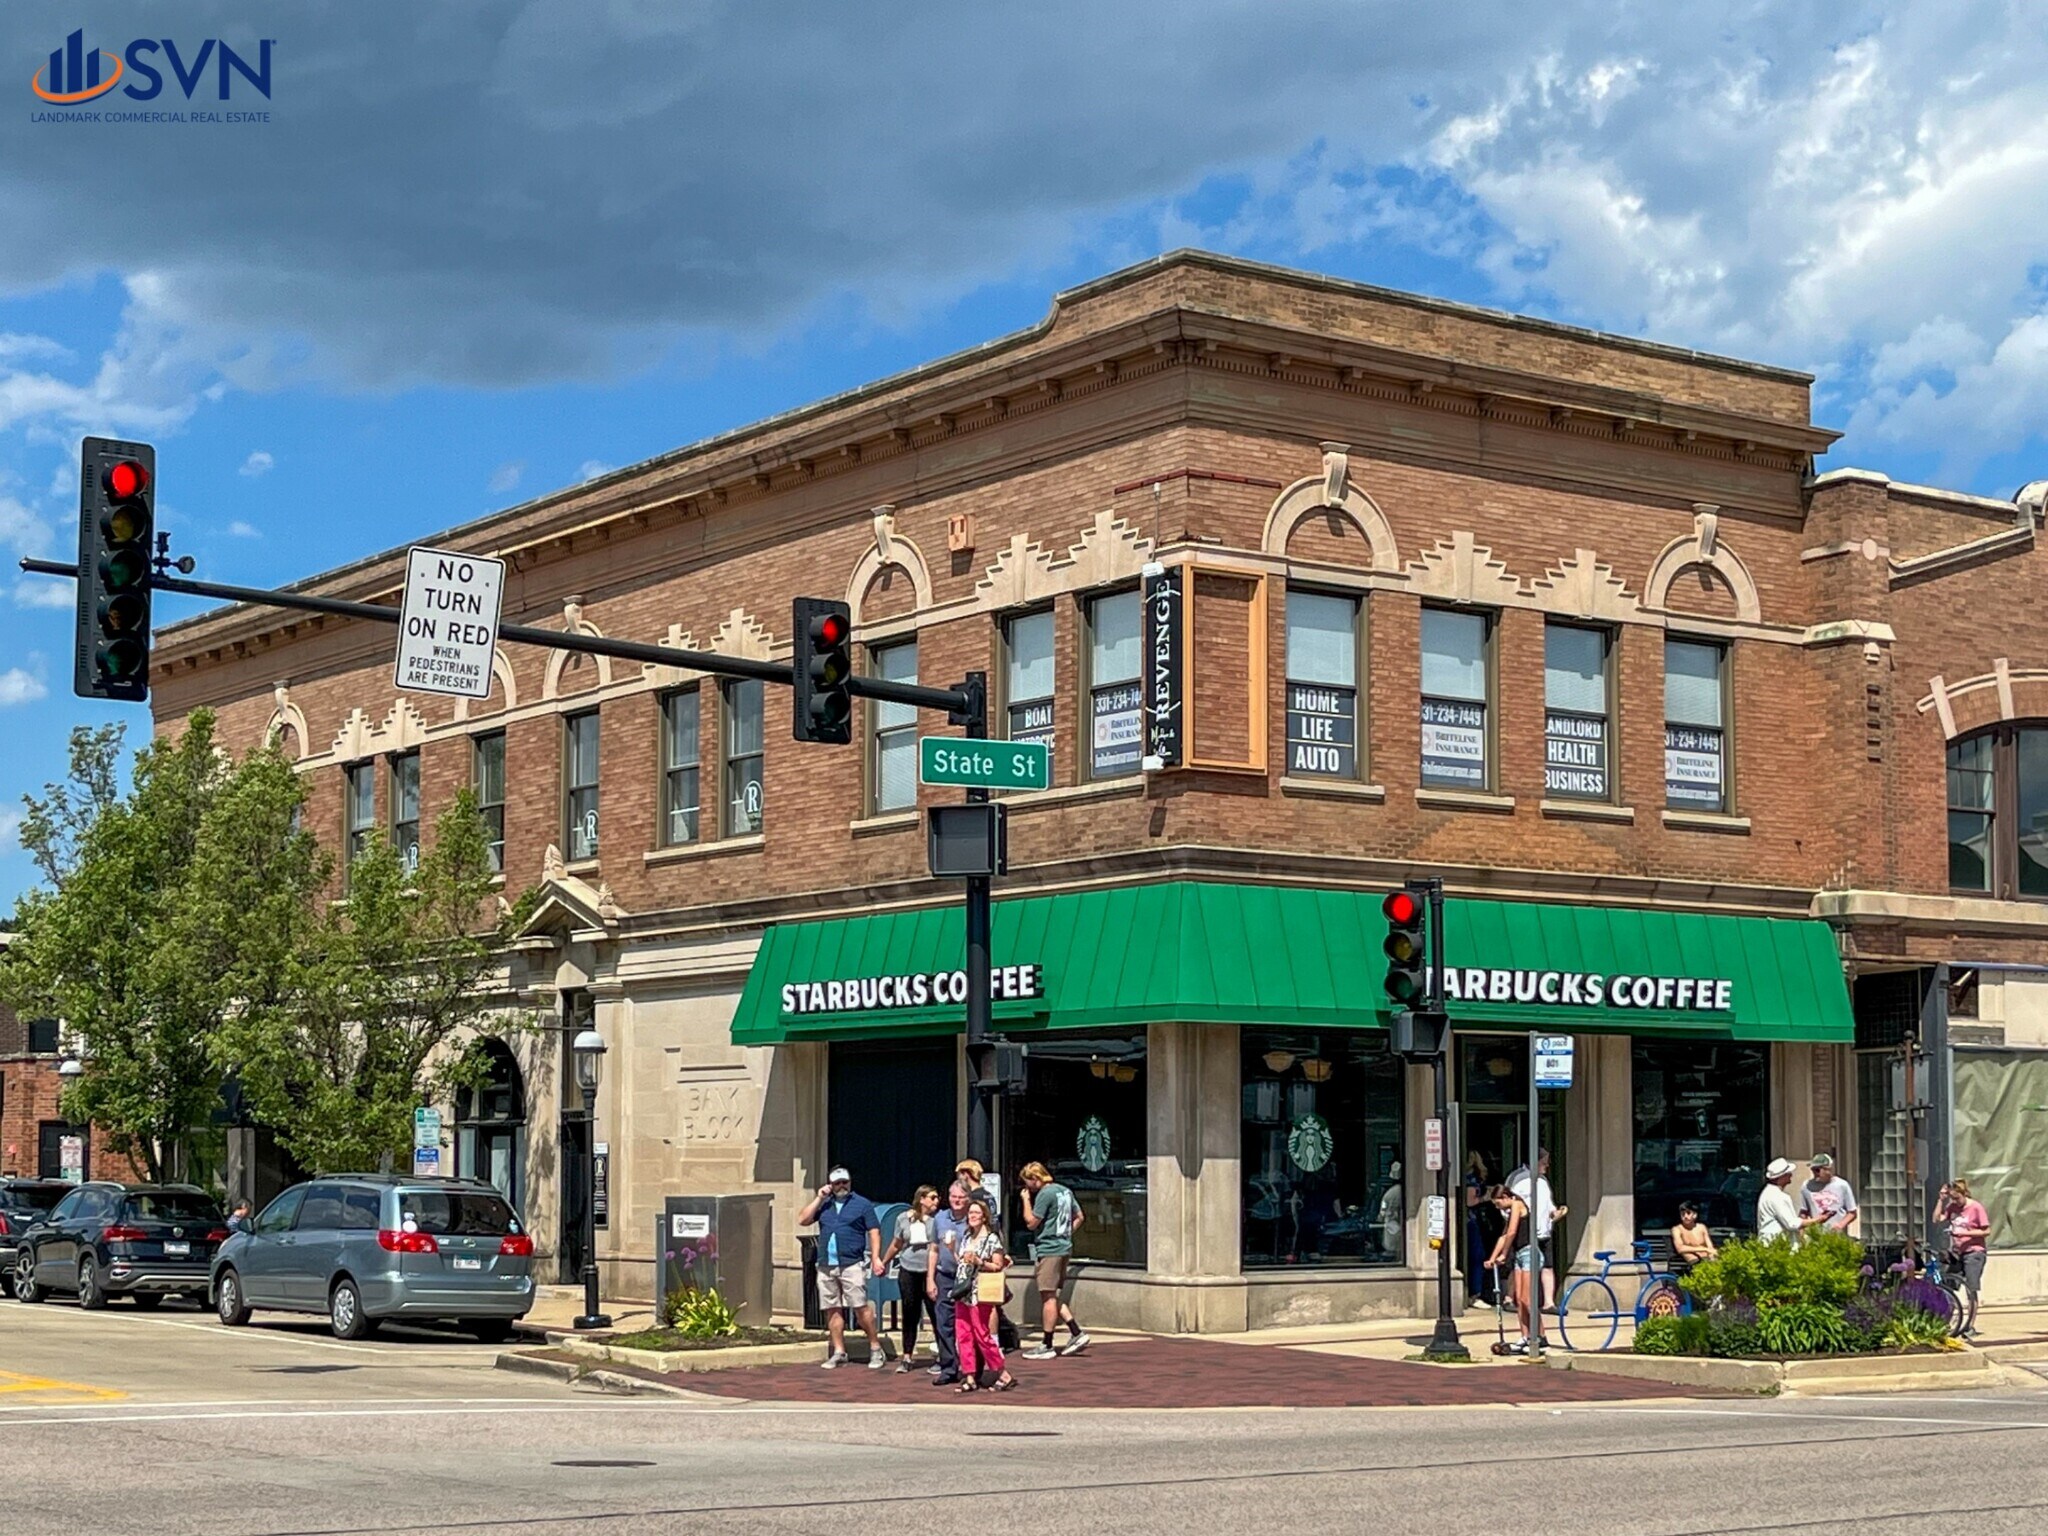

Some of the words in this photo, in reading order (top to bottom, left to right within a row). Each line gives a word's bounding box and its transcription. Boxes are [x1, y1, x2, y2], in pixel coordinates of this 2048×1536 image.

[437, 559, 474, 583] NO
[425, 588, 482, 615] TURN
[408, 617, 436, 640] ON
[448, 622, 489, 646] RED
[432, 645, 461, 660] WHEN
[1156, 579, 1171, 722] REVENGE
[409, 656, 480, 676] PEDESTRIANS
[407, 671, 428, 684] ARE
[432, 673, 479, 690] PRESENT
[1295, 687, 1340, 714] HOME
[1025, 704, 1052, 728] BOAT
[1421, 702, 1481, 726] 31-234-7449
[1301, 716, 1334, 741] LIFE
[933, 749, 994, 776] State
[1012, 754, 1036, 778] St
[1295, 745, 1340, 773] AUTO
[1547, 740, 1596, 765] HEALTH
[1544, 769, 1604, 793] BUSINESS
[782, 972, 928, 1013] STARBUCKS
[932, 964, 1035, 1003] COFEE
[1425, 965, 1604, 1005] ARBUCKS
[1611, 975, 1733, 1009] COFFEE
